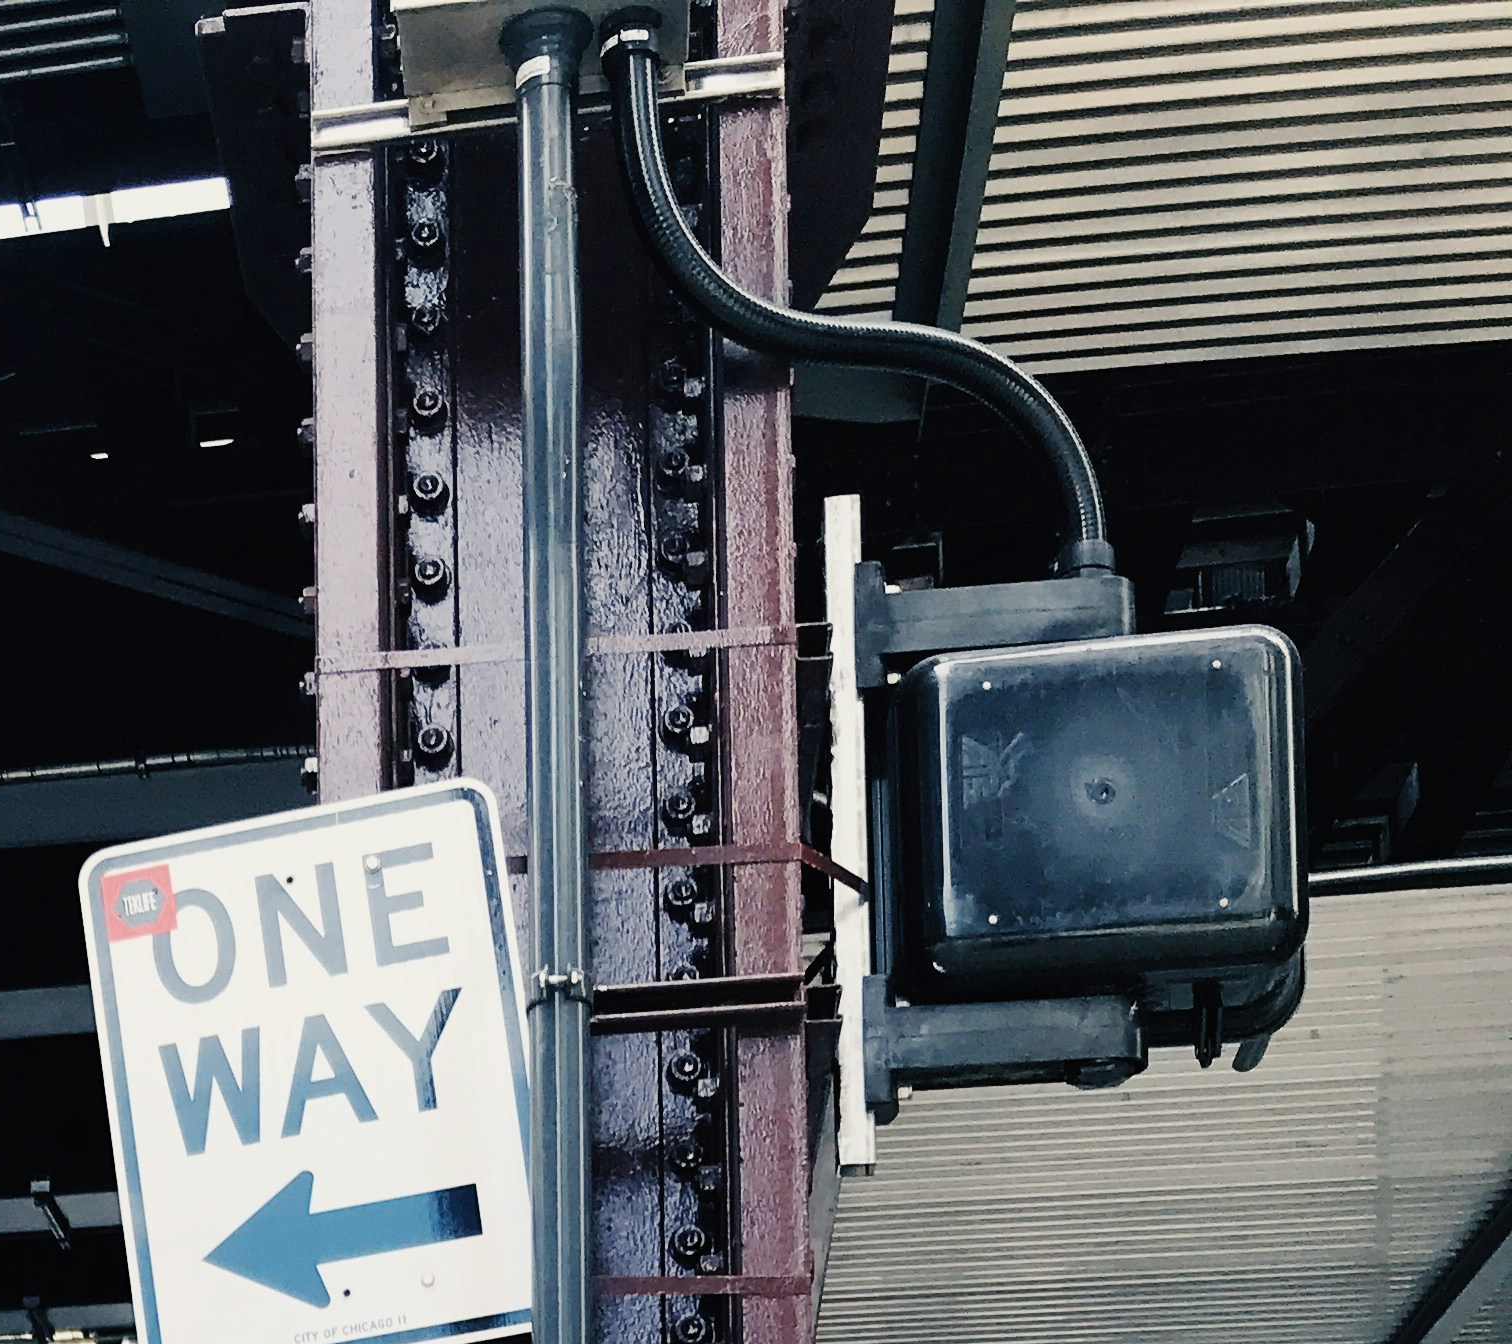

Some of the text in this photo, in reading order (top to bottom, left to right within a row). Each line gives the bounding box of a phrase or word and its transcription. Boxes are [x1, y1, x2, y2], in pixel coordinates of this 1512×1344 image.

[152, 842, 450, 1004] ONE
[158, 987, 463, 1157] WAY
[294, 1331, 319, 1344] CITY
[323, 1327, 337, 1339] OF
[342, 1317, 393, 1336] CHICAGO
